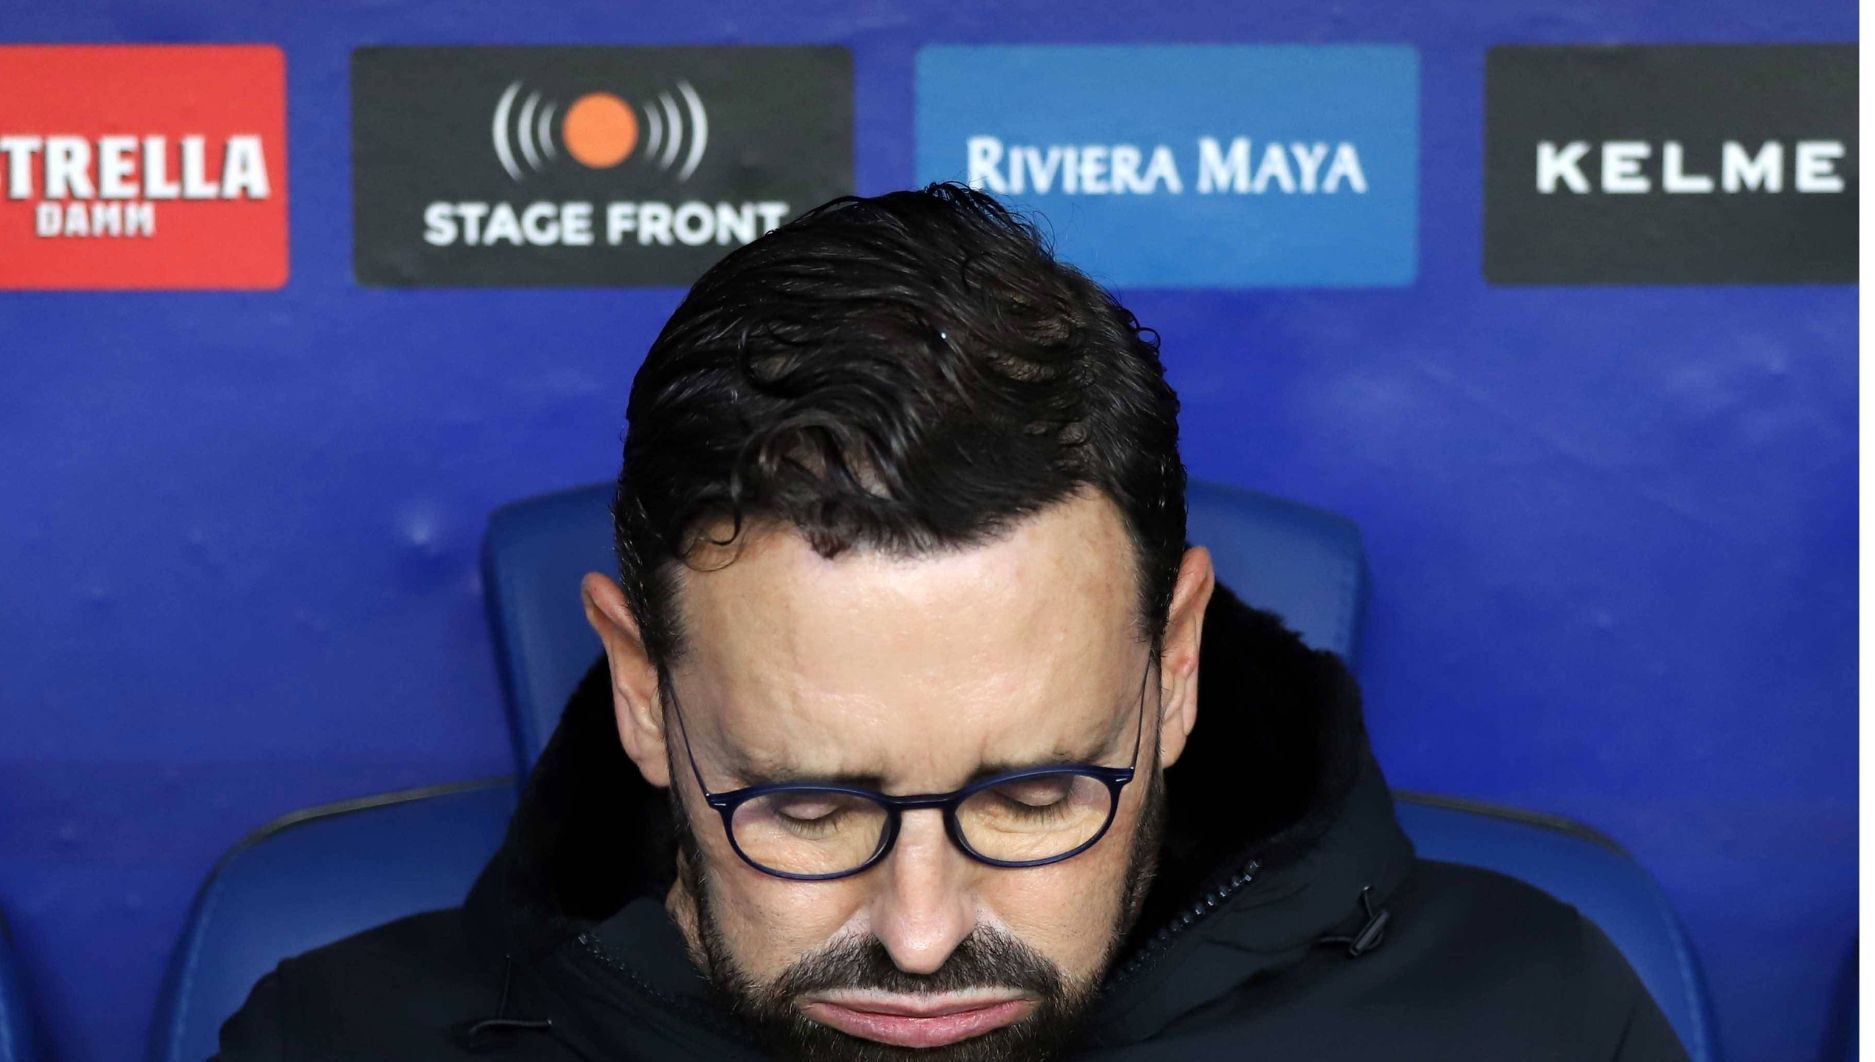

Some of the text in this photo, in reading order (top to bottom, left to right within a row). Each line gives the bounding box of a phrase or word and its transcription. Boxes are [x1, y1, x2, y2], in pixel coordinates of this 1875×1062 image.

[0, 135, 268, 199] TRELLA
[1196, 136, 1368, 195] MAYA
[1535, 141, 1846, 194] KELME
[35, 202, 157, 238] DAMM
[423, 201, 790, 247] STAGE FRONT
